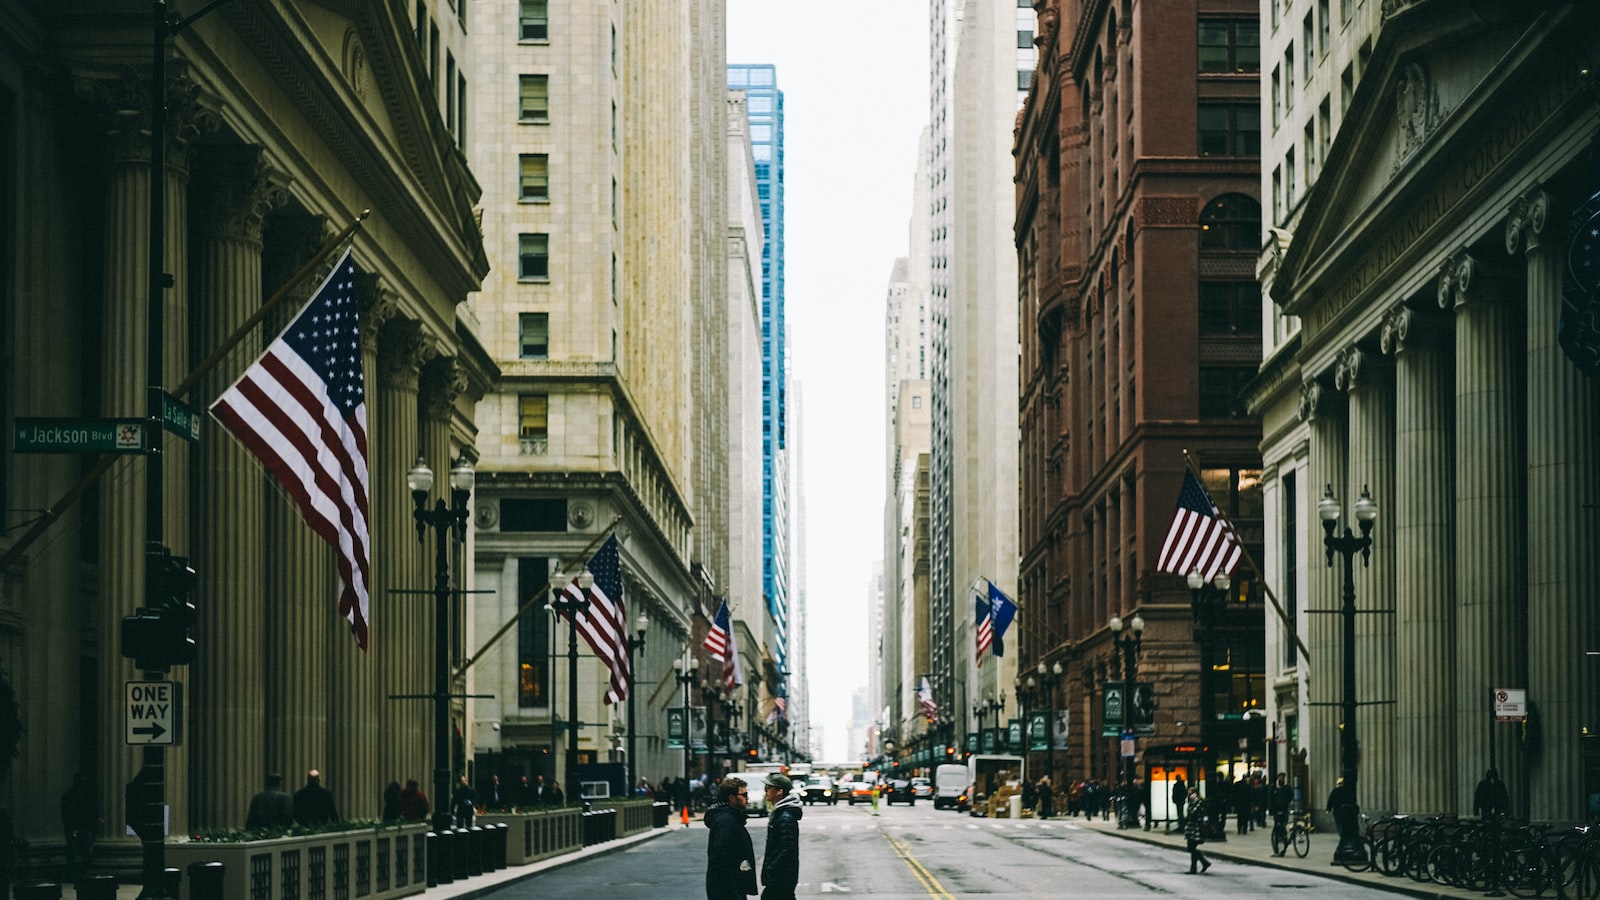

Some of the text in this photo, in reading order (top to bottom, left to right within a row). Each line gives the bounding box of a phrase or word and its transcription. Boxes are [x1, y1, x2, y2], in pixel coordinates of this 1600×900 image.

[1314, 259, 1369, 329] WINTRUST
[1376, 183, 1451, 274] FINANCIAL
[19, 426, 113, 444] W Jackson Blvd
[131, 686, 169, 702] ONE
[130, 703, 169, 720] WAY
